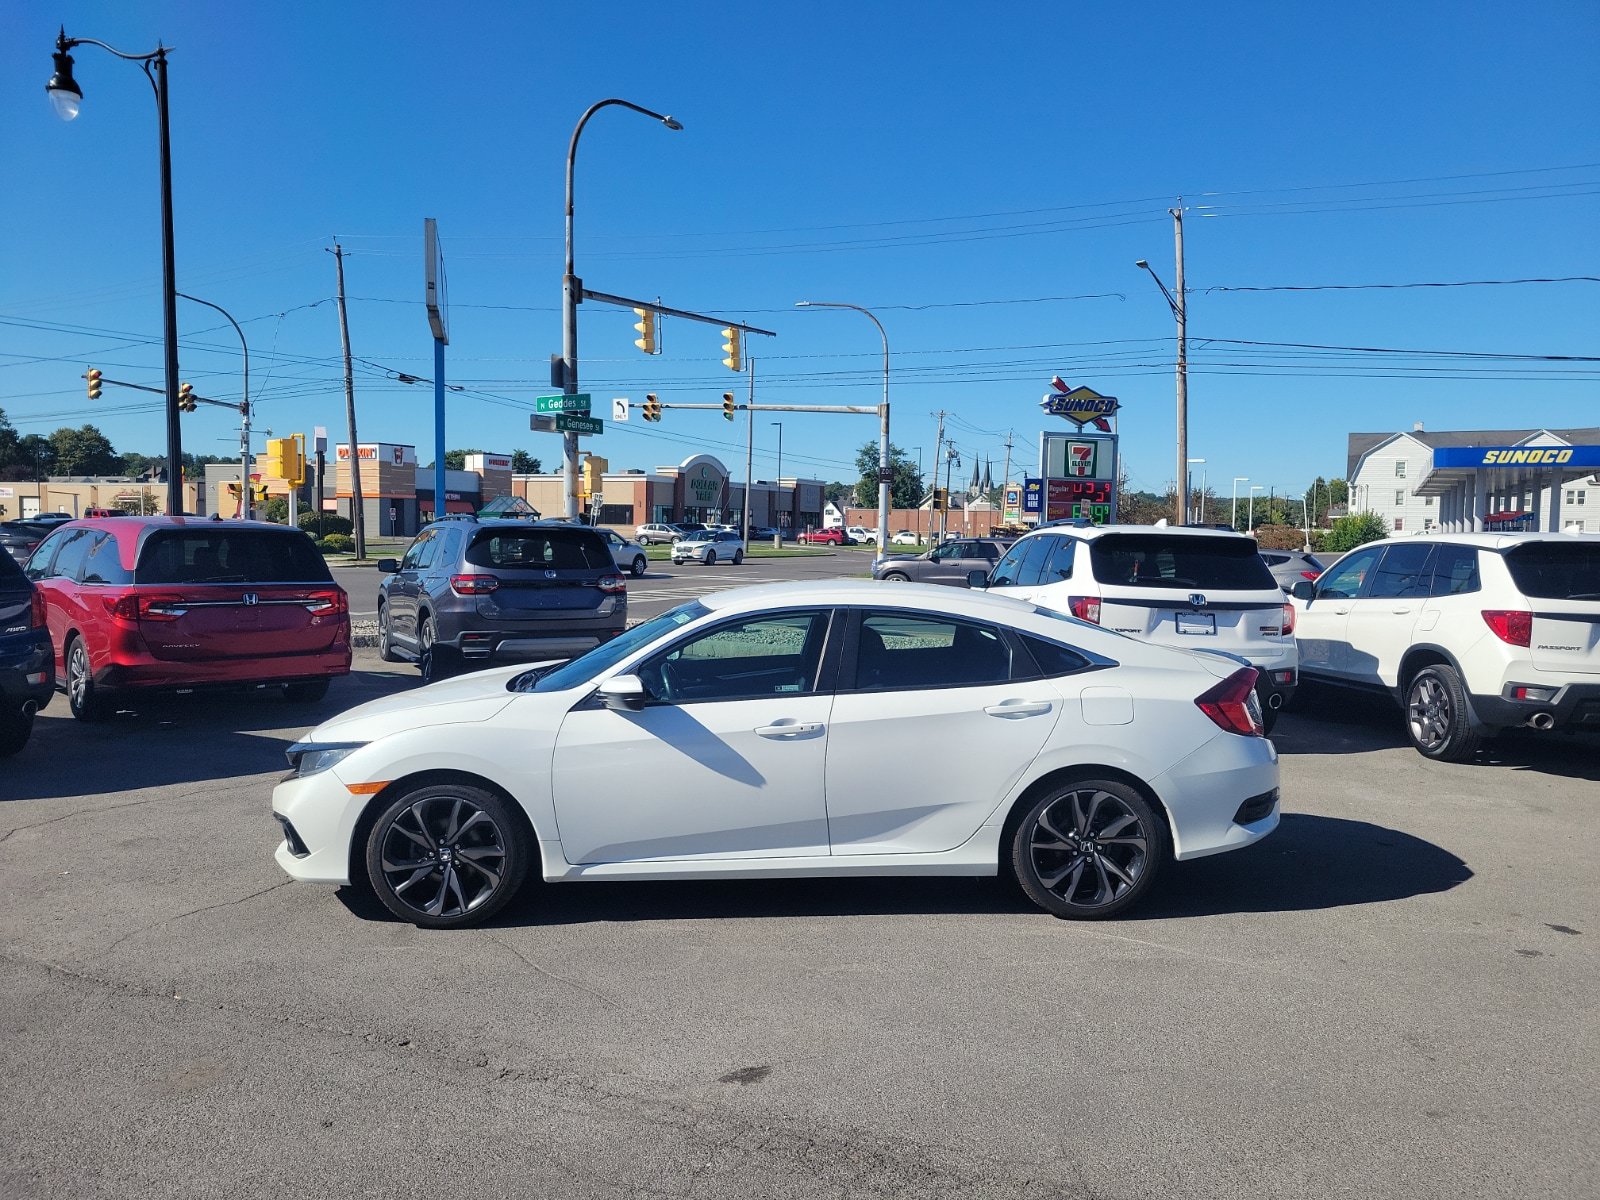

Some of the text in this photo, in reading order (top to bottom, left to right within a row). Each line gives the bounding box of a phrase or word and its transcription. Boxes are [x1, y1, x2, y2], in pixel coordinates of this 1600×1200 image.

[548, 399, 577, 409] Geddes
[1054, 399, 1116, 413] SUNOCO
[567, 418, 594, 431] Genesee
[338, 447, 375, 459] DUKIN'
[1482, 449, 1574, 464] SUNOCO
[691, 480, 717, 491] DOLLAR
[1049, 485, 1069, 493] Regular
